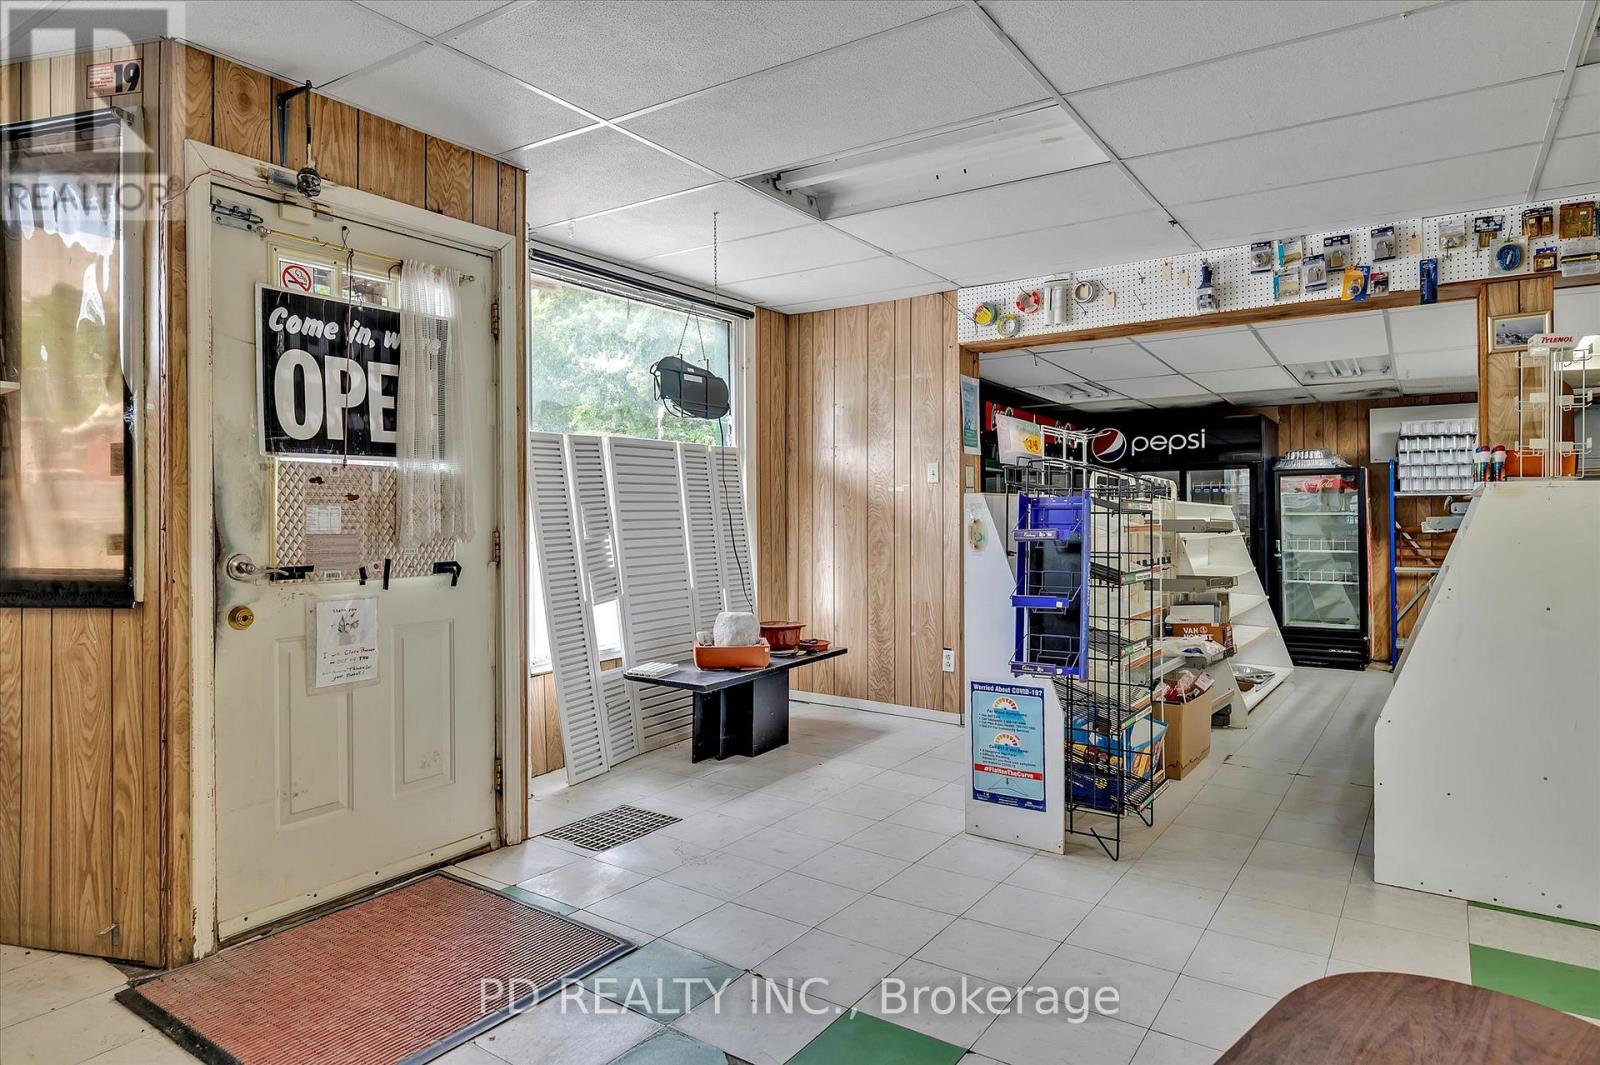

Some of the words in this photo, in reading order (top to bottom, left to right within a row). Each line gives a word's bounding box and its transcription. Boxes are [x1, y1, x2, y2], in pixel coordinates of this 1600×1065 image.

[114, 62, 140, 92] 19
[268, 306, 339, 340] Come
[347, 319, 375, 349] in,
[1541, 336, 1573, 344] TYLENOL
[274, 348, 400, 443] OPE
[1131, 428, 1206, 456] pepsi
[973, 683, 994, 692] Worried
[994, 685, 1011, 694] About
[1011, 688, 1043, 697] COVID-19?
